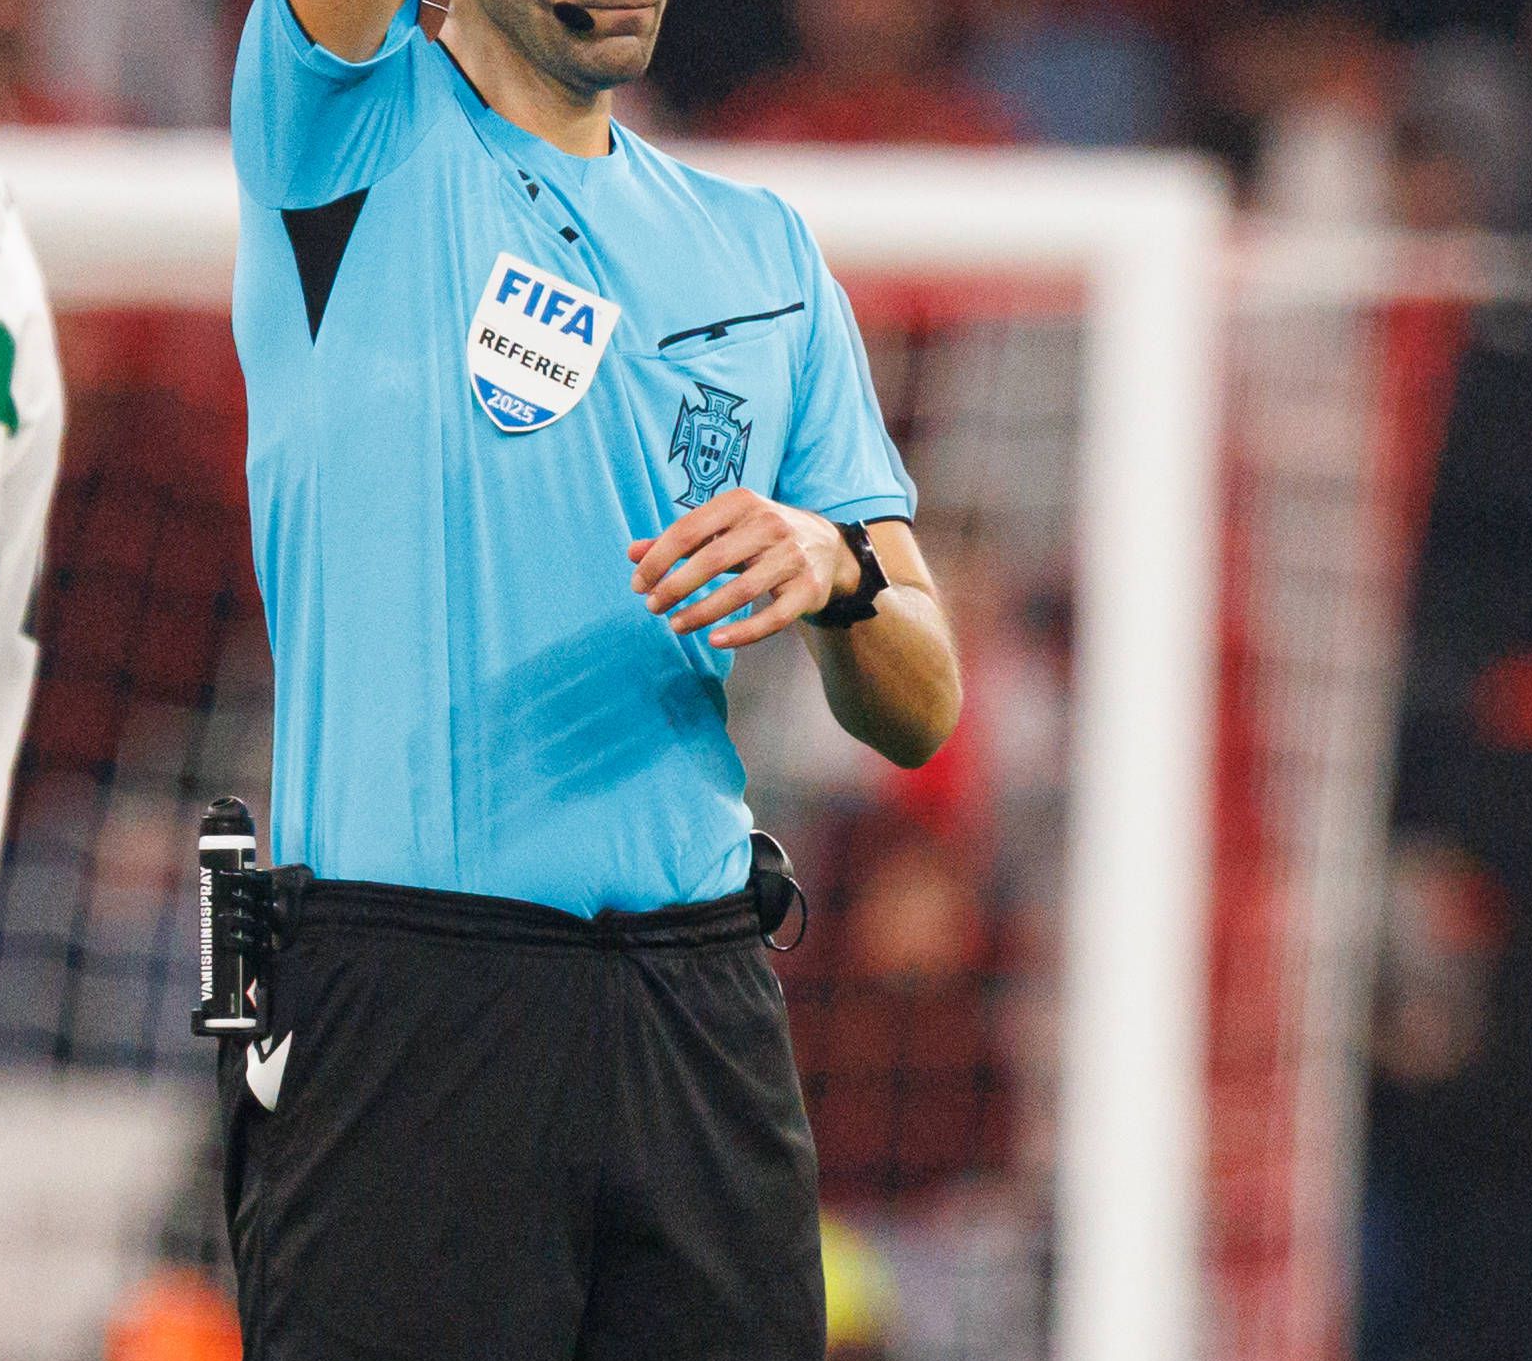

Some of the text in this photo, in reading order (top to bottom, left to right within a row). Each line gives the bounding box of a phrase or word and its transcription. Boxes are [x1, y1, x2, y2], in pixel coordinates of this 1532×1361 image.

[495, 267, 595, 346] FIFA
[479, 327, 580, 390] REFEREE
[487, 389, 538, 424] 2025
